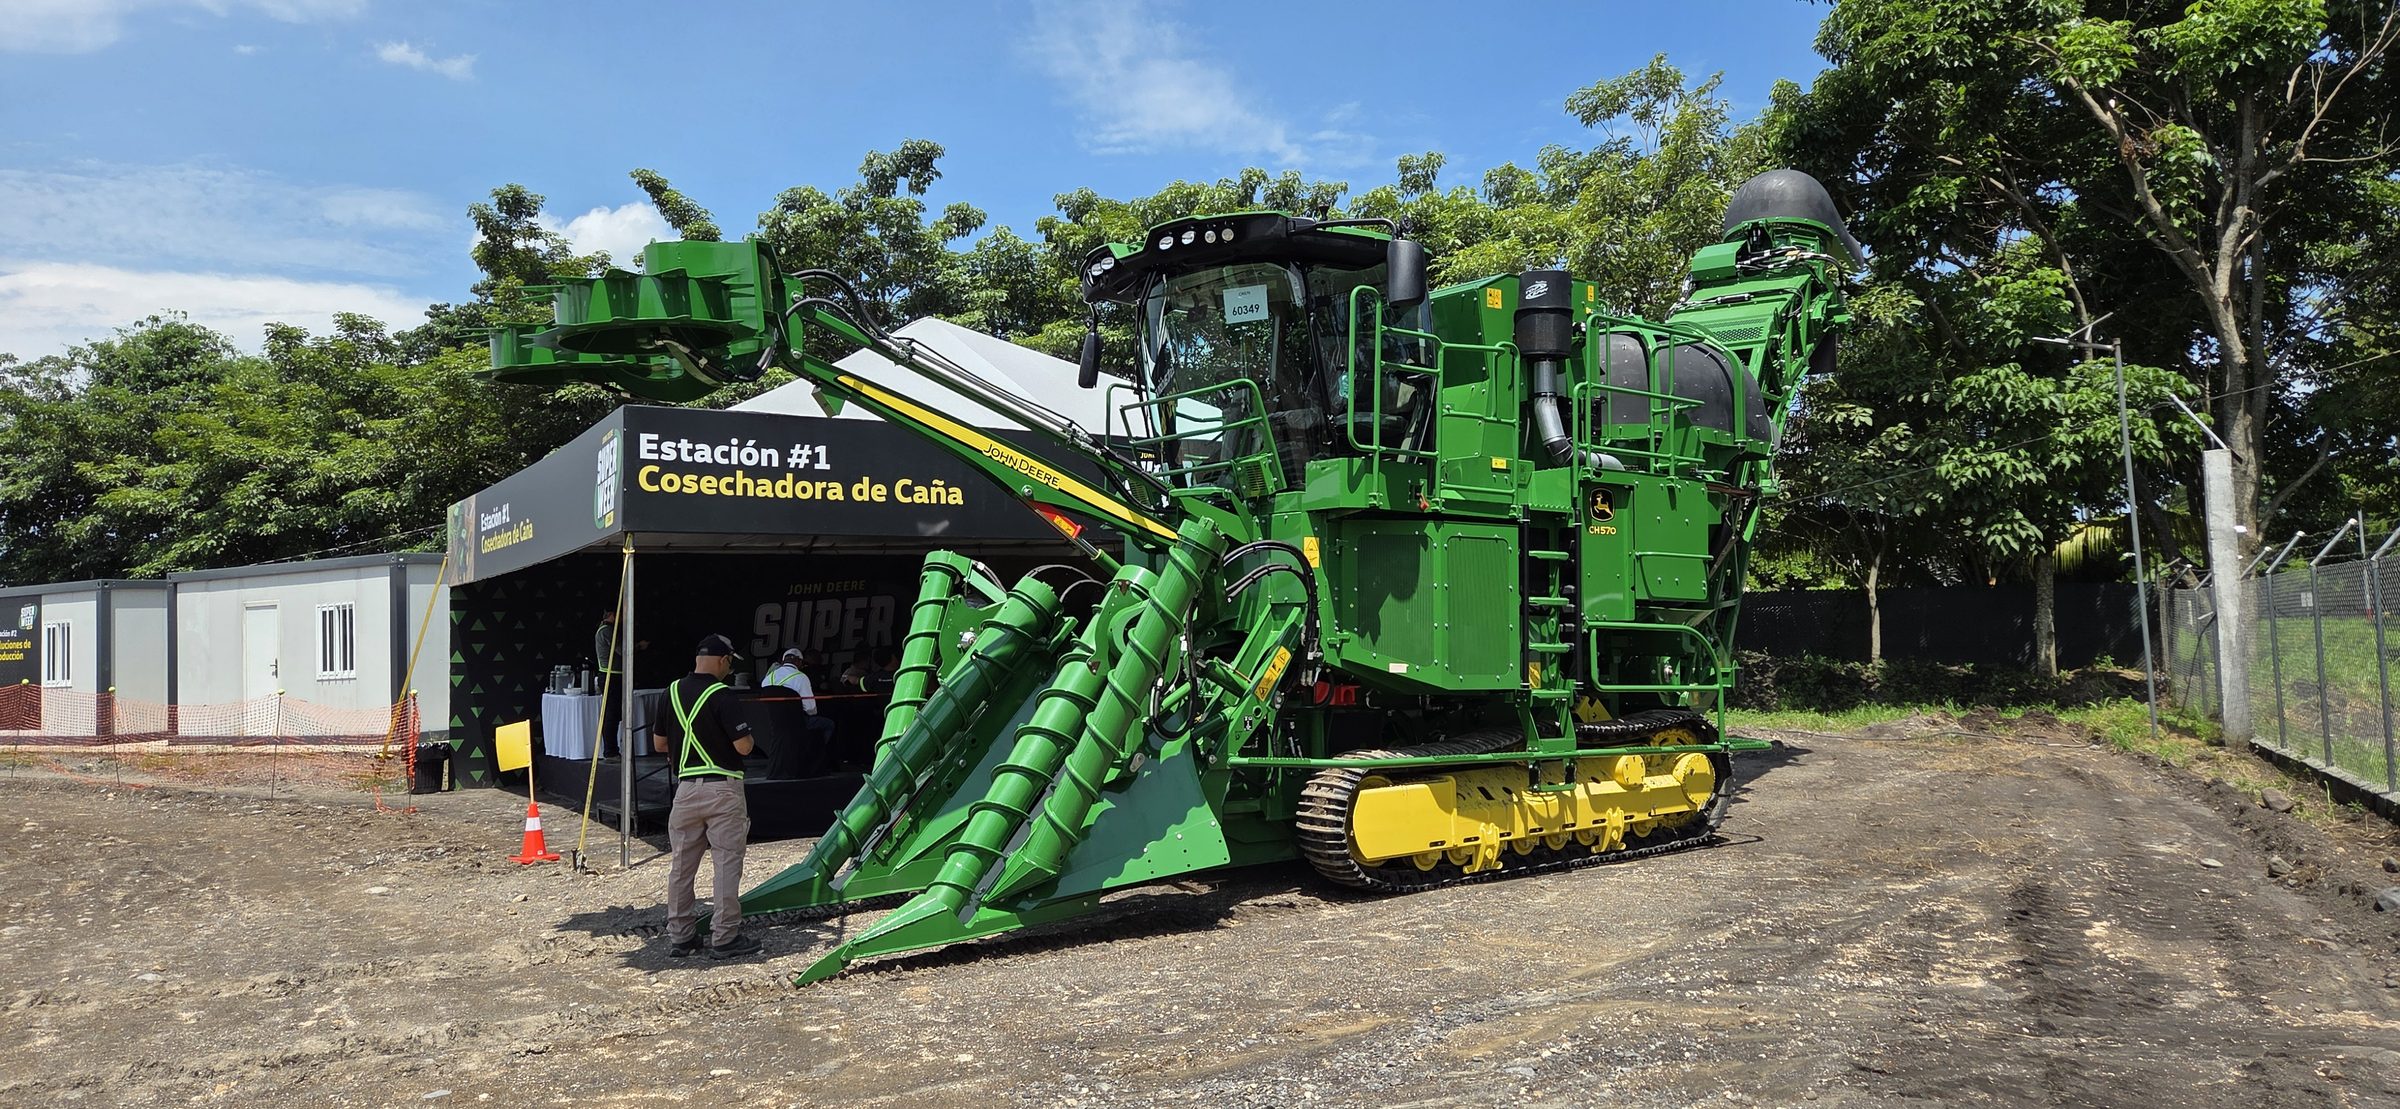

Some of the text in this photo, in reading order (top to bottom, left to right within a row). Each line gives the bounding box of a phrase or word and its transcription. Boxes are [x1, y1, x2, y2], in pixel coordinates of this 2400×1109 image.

[1232, 303, 1260, 316] 60349
[639, 433, 779, 467] Estación
[787, 443, 831, 470] #1
[983, 443, 1060, 487] JOHN DEERE
[638, 465, 964, 505] Cosechadora de Caña
[481, 503, 510, 532] Estación #1
[1589, 525, 1617, 535] CH570
[482, 518, 533, 554] Cosechadora de Caña
[787, 579, 866, 596] JOHN DEERE
[750, 595, 896, 658] SUPER
[23, 638, 32, 649] de
